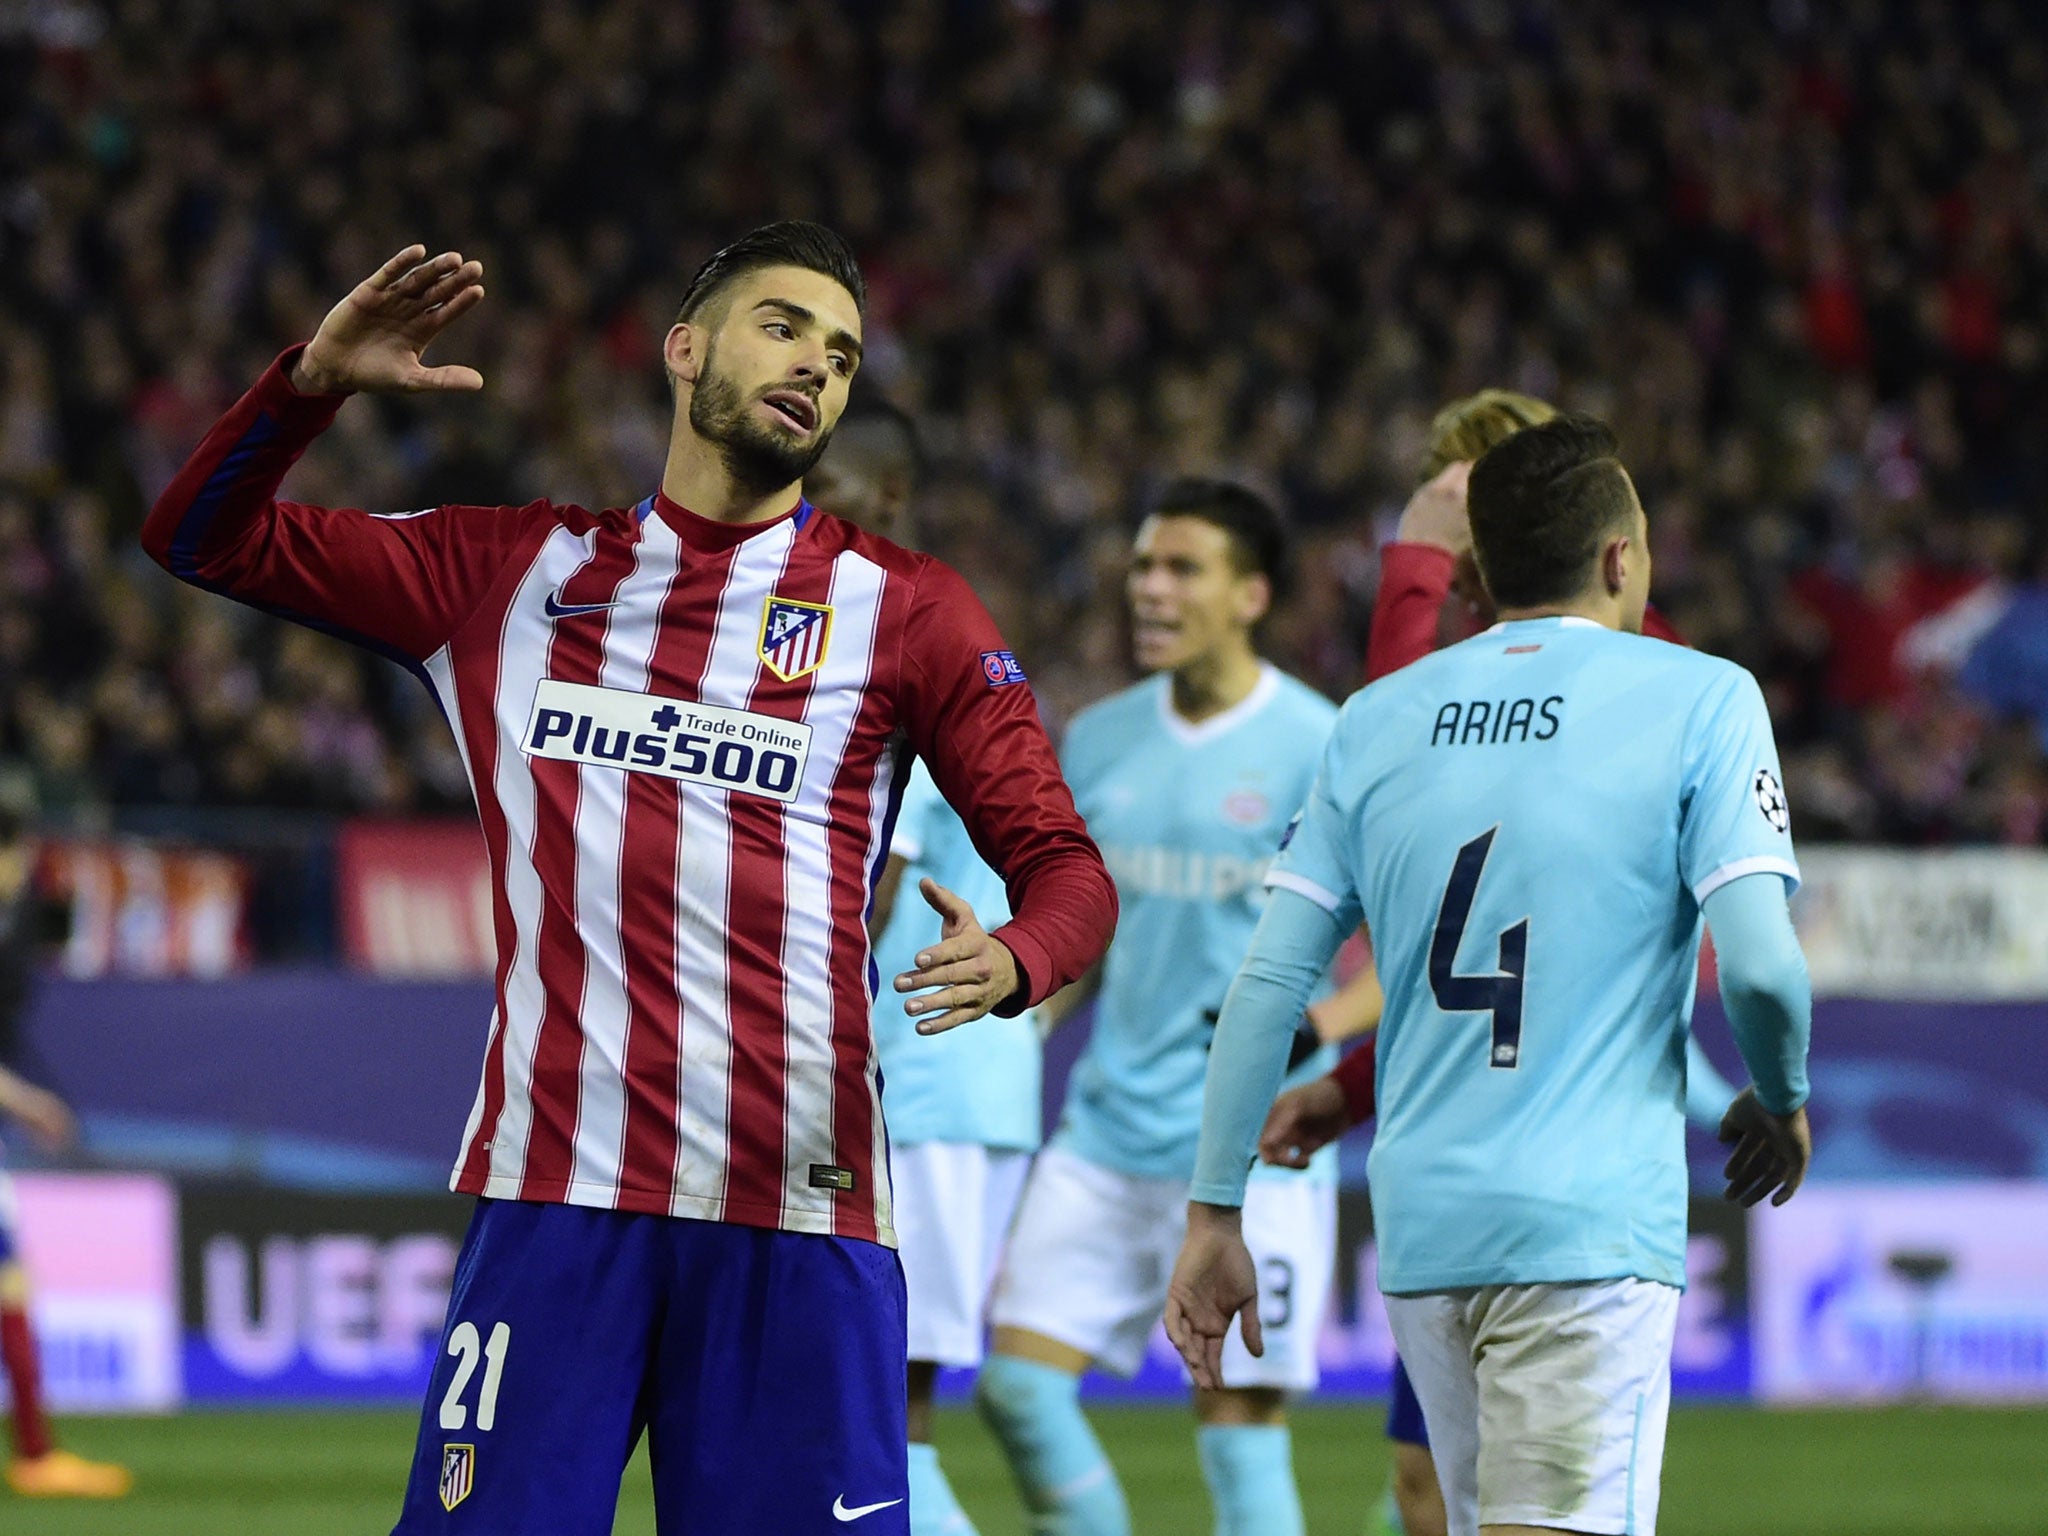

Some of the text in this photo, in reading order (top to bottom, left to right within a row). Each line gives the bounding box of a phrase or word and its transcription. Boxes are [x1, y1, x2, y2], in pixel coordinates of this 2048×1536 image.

[529, 707, 798, 793] Plus500
[685, 713, 802, 751] Trade Online
[1431, 695, 1564, 747] ARIAS
[1428, 822, 1531, 1069] 4
[1261, 1255, 1294, 1330] 3
[439, 1321, 511, 1431] 21
